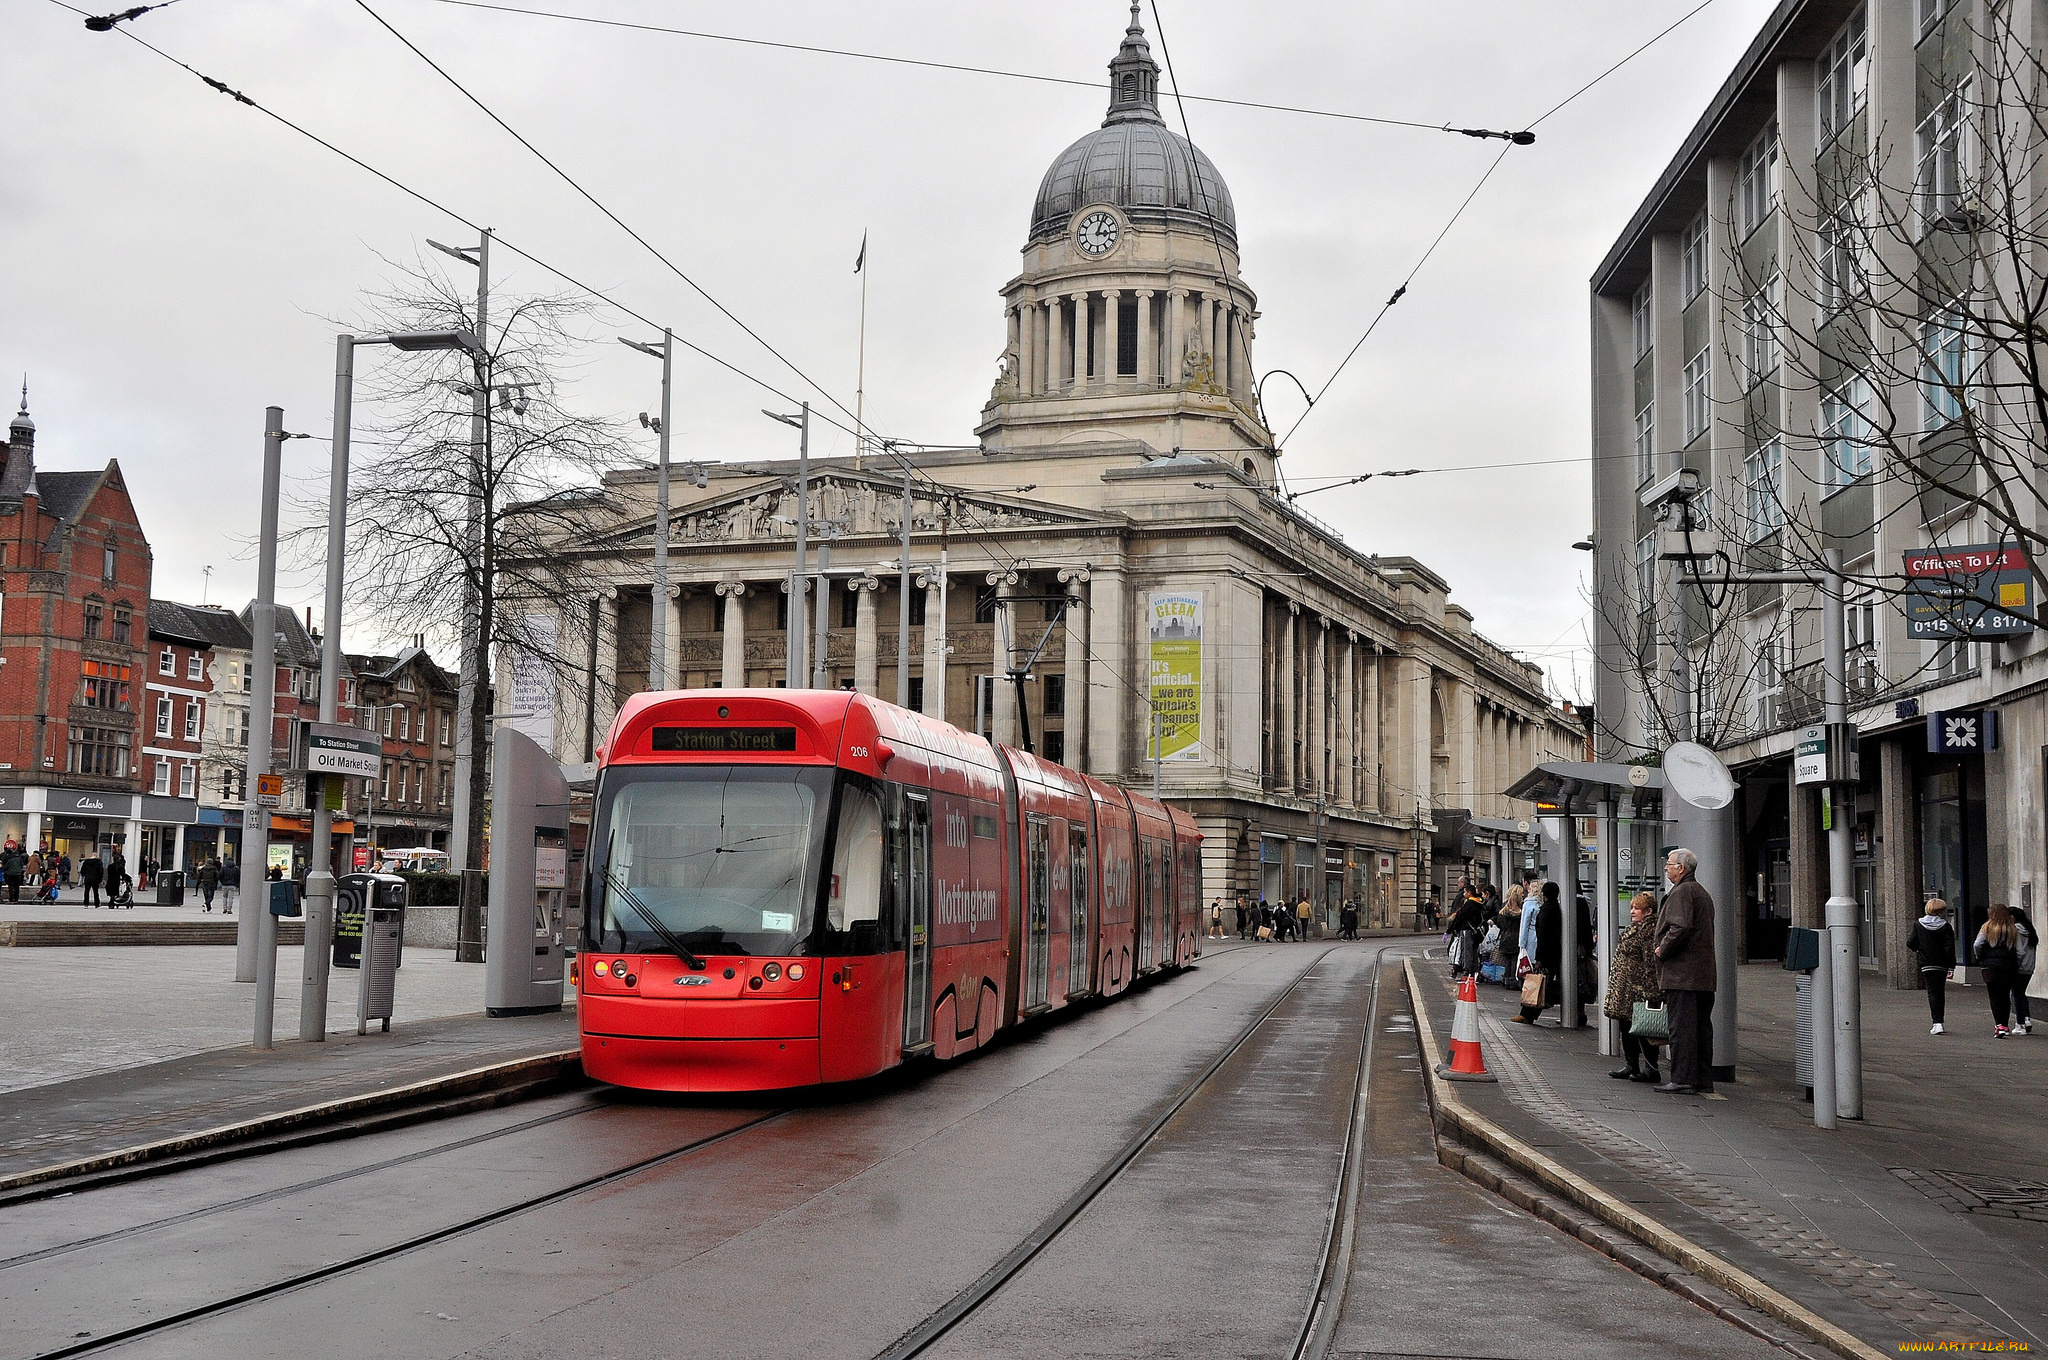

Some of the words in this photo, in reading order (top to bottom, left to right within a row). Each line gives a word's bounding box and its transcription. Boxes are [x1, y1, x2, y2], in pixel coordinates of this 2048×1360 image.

[1966, 555, 1982, 568] To
[1166, 597, 1198, 606] NOTTINGHAM
[2001, 598, 2025, 607] savills
[1155, 602, 1197, 618] CLEAN
[1151, 660, 1169, 673] It's
[1151, 672, 1200, 686] official...
[1176, 688, 1194, 699] are
[1151, 699, 1197, 711] Britain's
[319, 738, 327, 746] To
[327, 739, 346, 749] Station
[346, 741, 359, 750] Street
[675, 730, 724, 749] Station
[730, 730, 776, 749] Street
[850, 746, 868, 758] 206
[318, 754, 335, 767] Old
[337, 756, 363, 770] Market
[76, 797, 104, 810] Clarks
[945, 801, 967, 848] into
[938, 878, 996, 933] Nottingham
